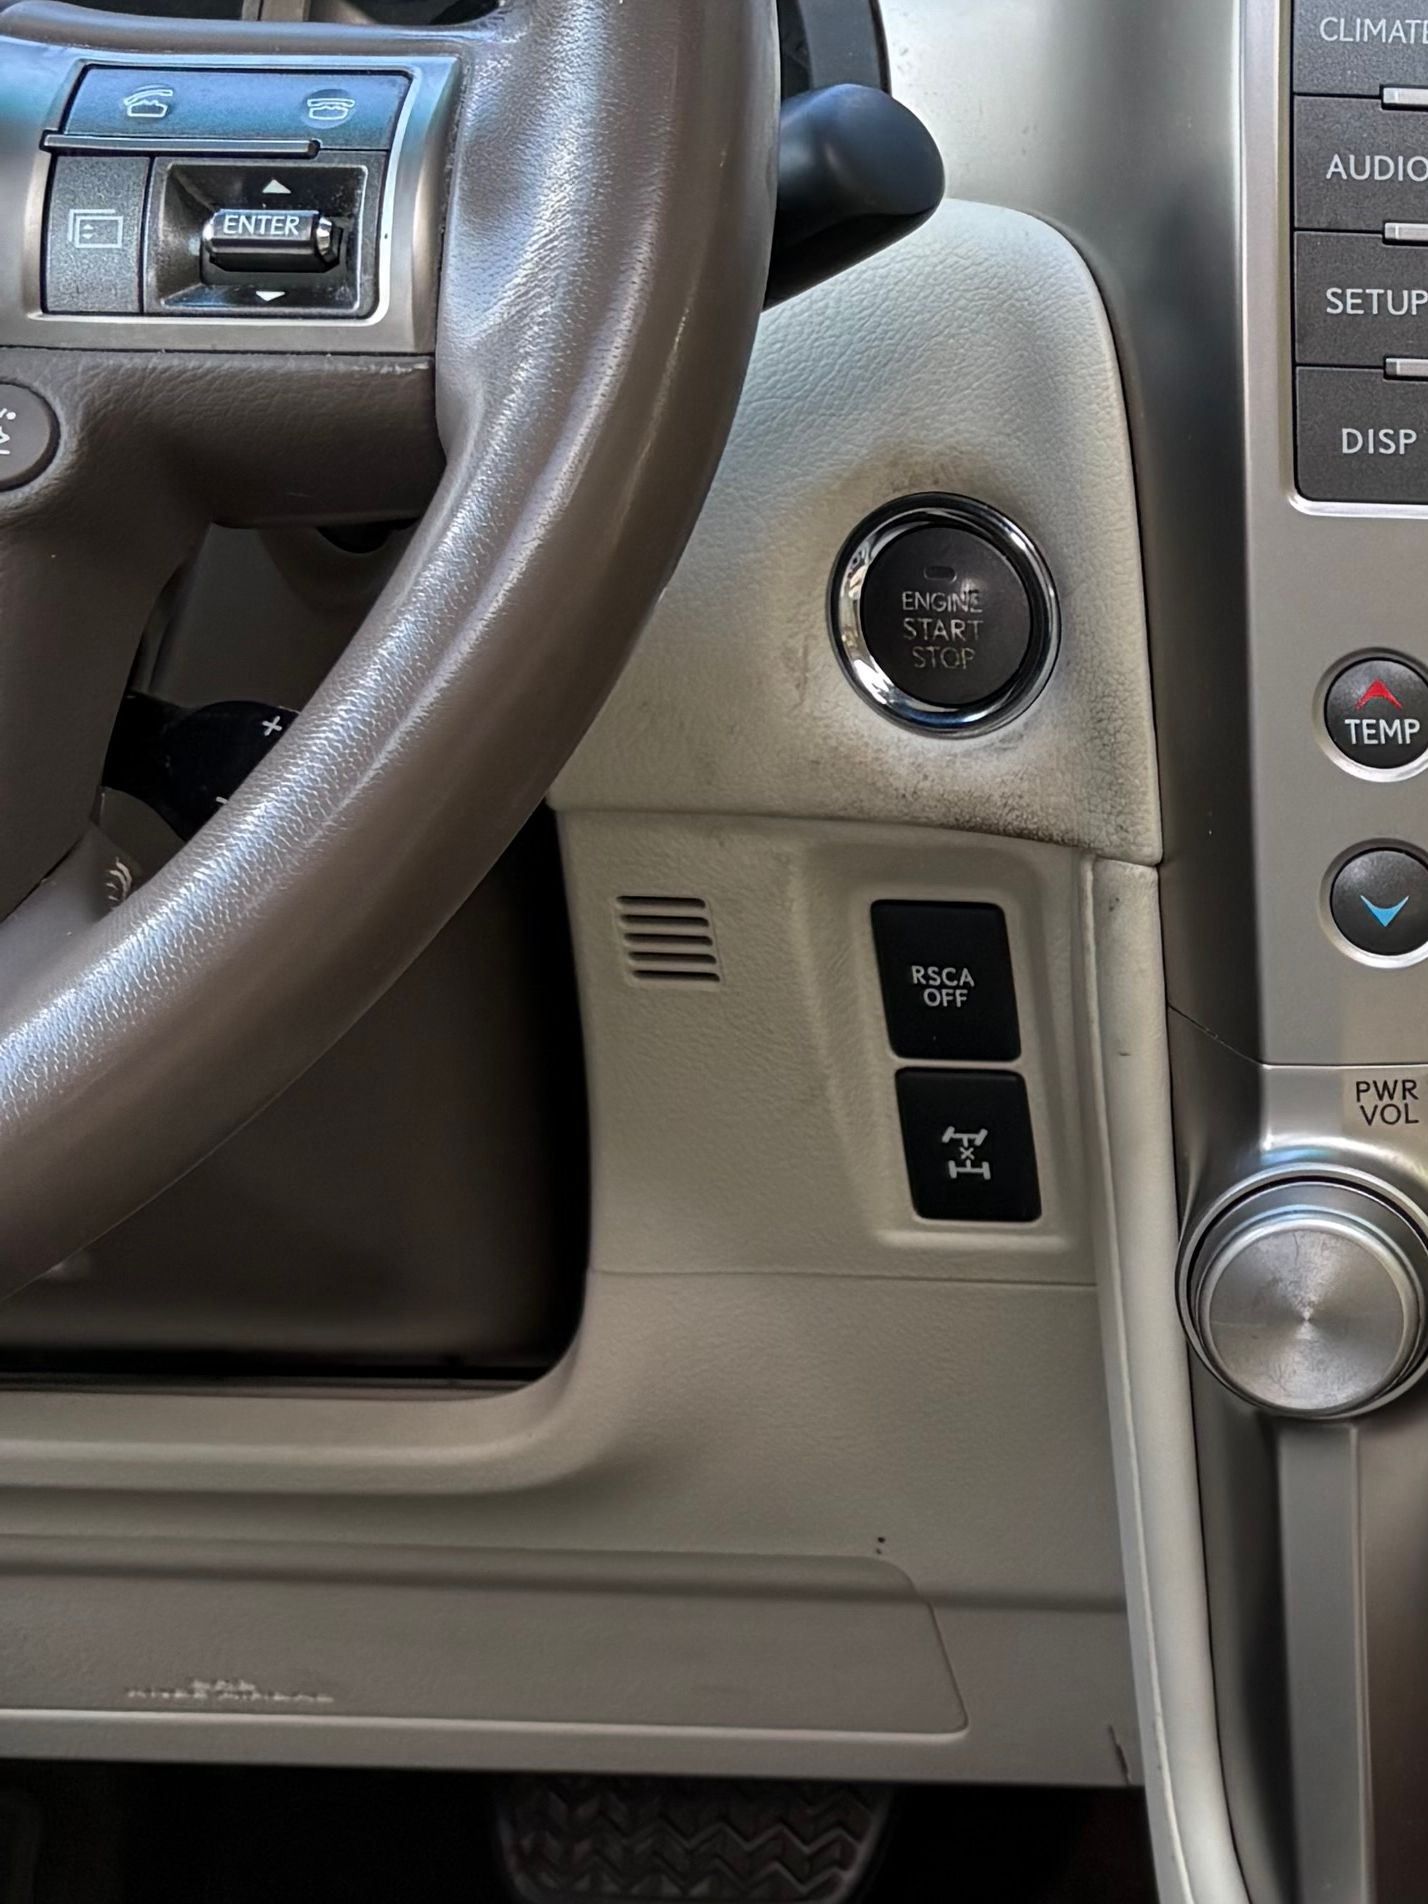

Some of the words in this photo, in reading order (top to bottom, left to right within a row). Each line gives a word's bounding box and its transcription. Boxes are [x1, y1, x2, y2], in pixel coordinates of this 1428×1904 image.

[222, 214, 301, 237] ENTER
[1326, 287, 1428, 316] SETUP
[1341, 427, 1417, 455] DISP
[902, 588, 983, 613] ENGINE
[903, 617, 984, 641] START
[912, 645, 976, 670] STOP
[1344, 718, 1421, 745] TEMP
[911, 965, 976, 988] RSCA
[923, 988, 968, 1008] OFF
[1355, 1079, 1419, 1103] PWR
[1359, 1102, 1420, 1127] VOL
